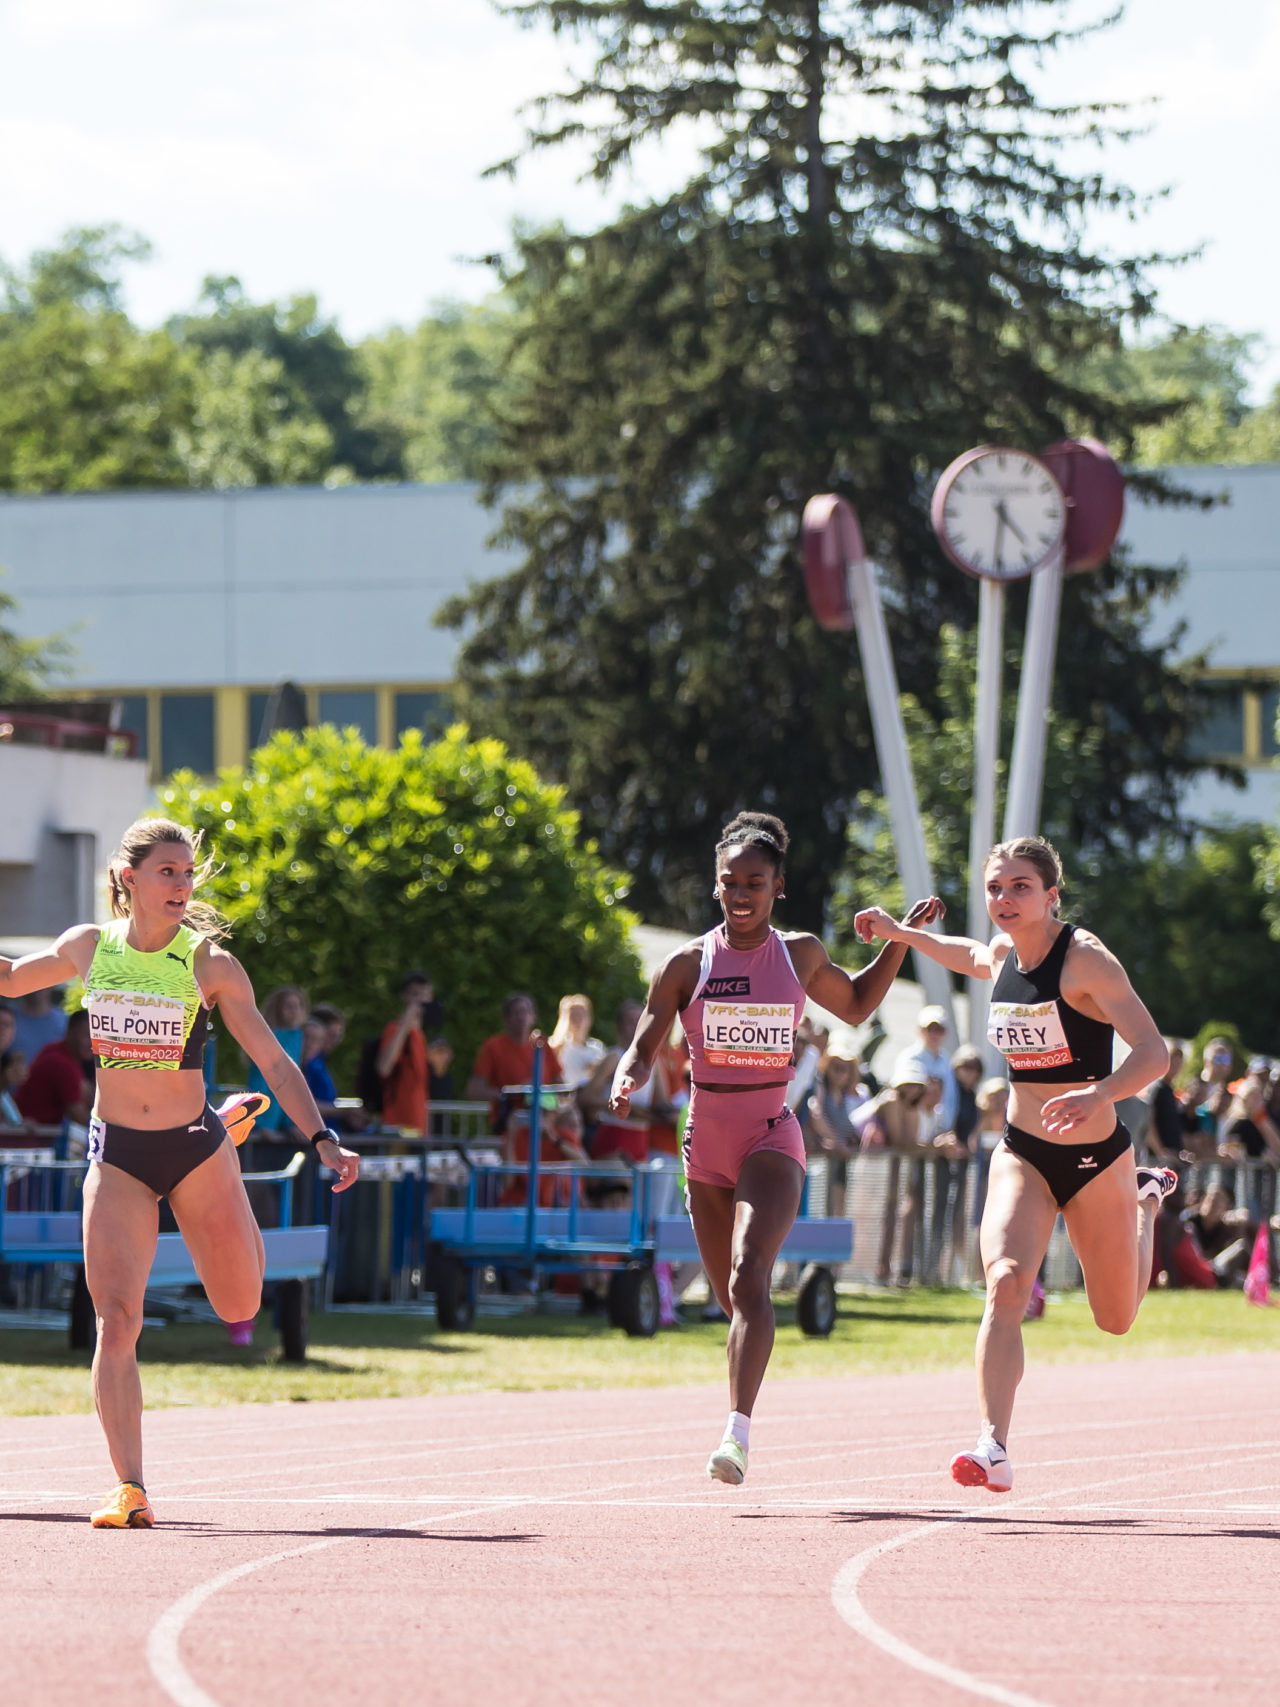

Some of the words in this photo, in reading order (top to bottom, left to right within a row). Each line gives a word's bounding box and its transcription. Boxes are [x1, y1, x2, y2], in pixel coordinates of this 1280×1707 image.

[701, 981, 748, 995] NIKE
[91, 1014, 119, 1033] DEL
[124, 1018, 182, 1036] PONTE
[706, 1025, 790, 1044] LECONTE
[996, 1027, 1046, 1046] FREY
[112, 1047, 180, 1060] Genève2022
[728, 1054, 789, 1067] Genève2022
